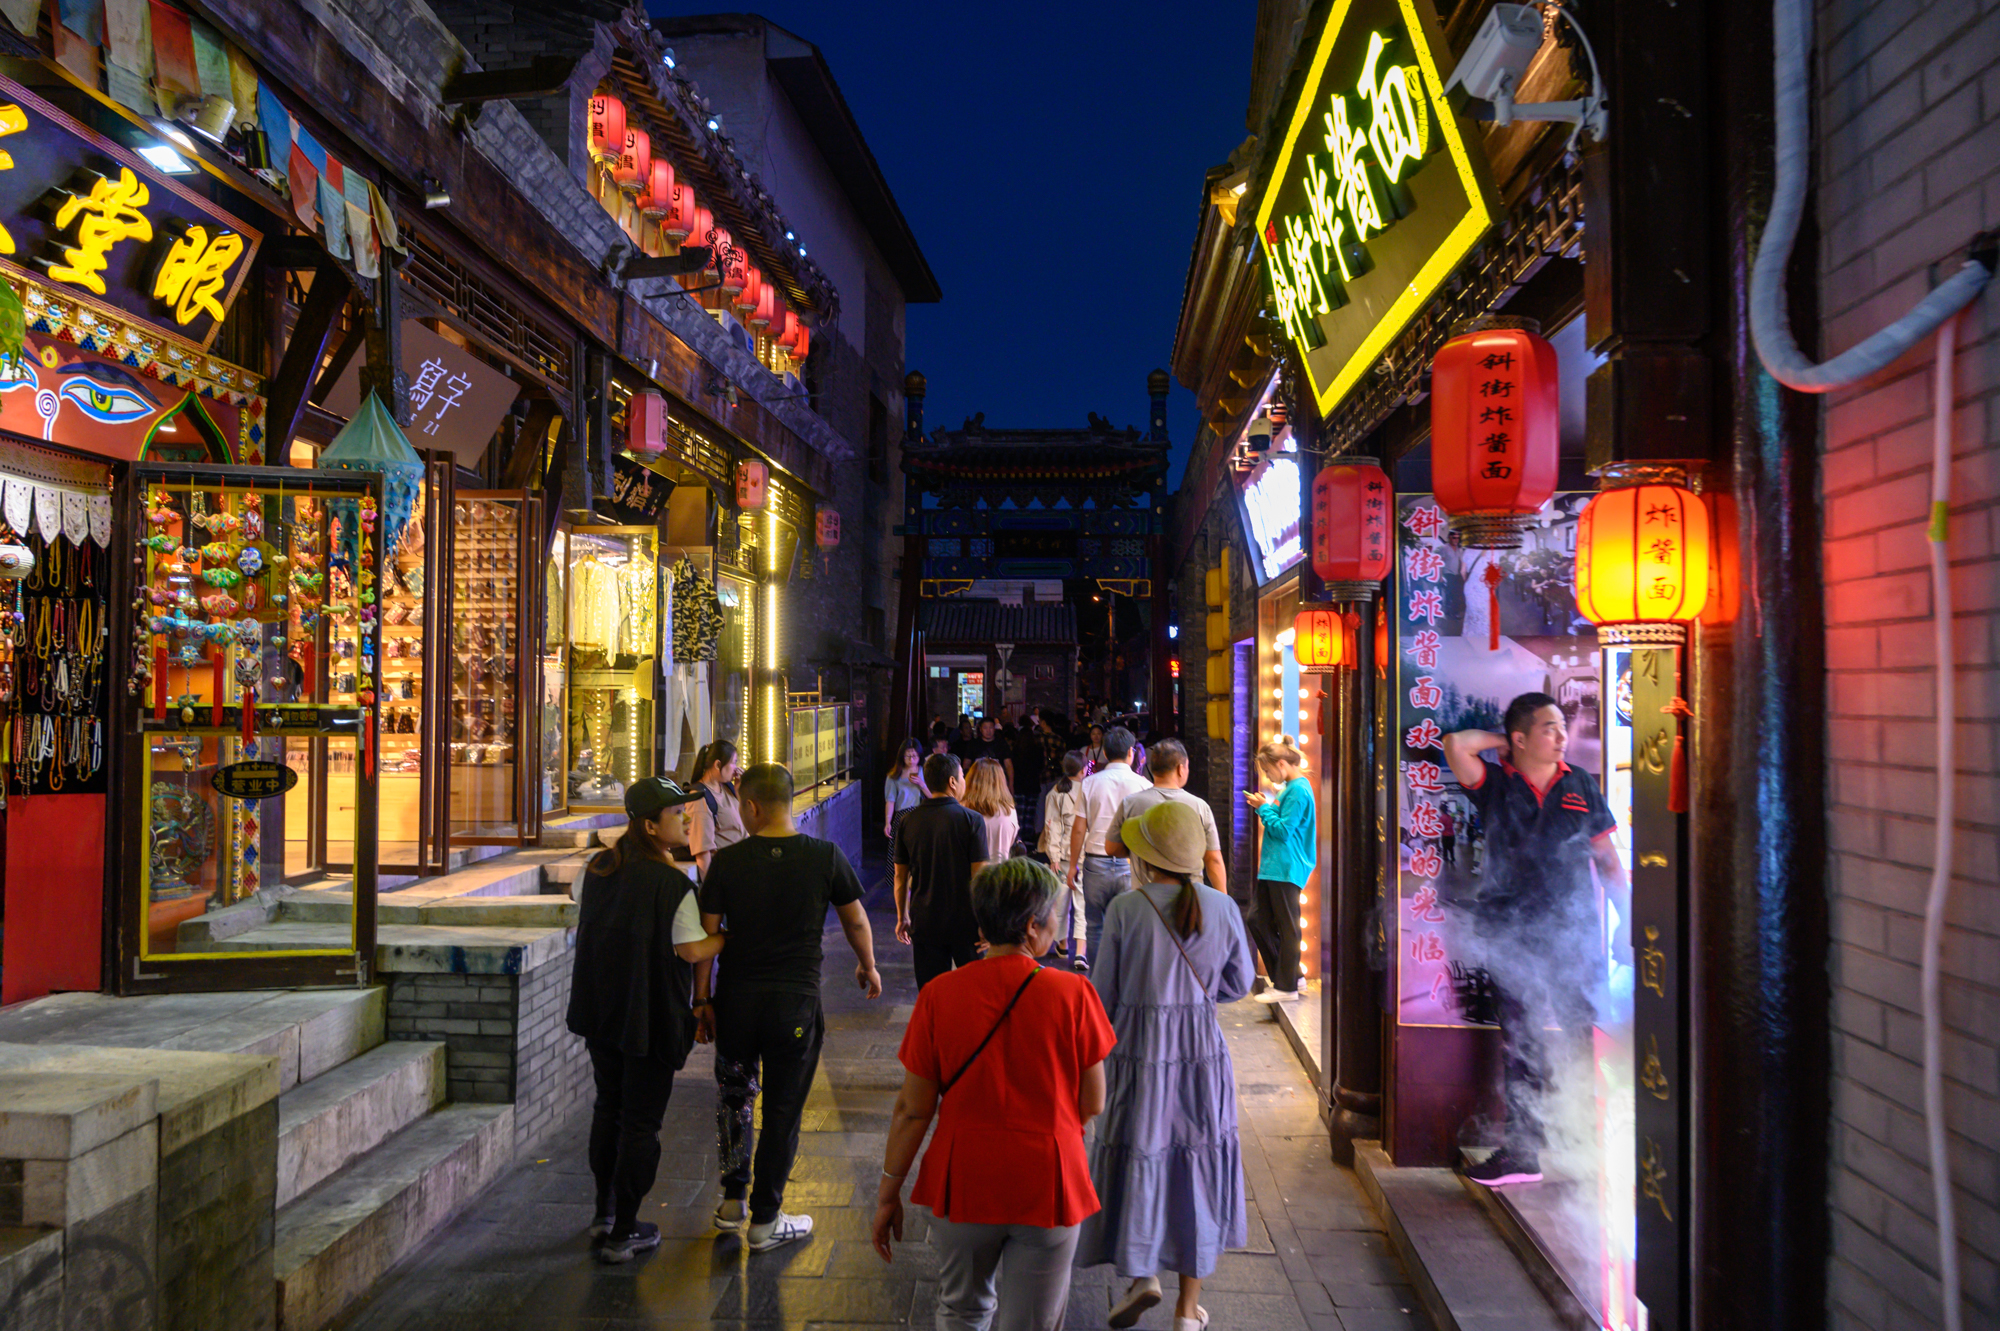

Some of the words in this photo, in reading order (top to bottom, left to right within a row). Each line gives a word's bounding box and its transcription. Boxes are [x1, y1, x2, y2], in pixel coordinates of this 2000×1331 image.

[0, 103, 244, 326] 堂眼
[1476, 352, 1517, 480] 斜街炸酱面
[1365, 481, 1384, 562] 斜街炸酱面
[1643, 503, 1678, 601] 炸酱面
[231, 779, 280, 793] 营业中
